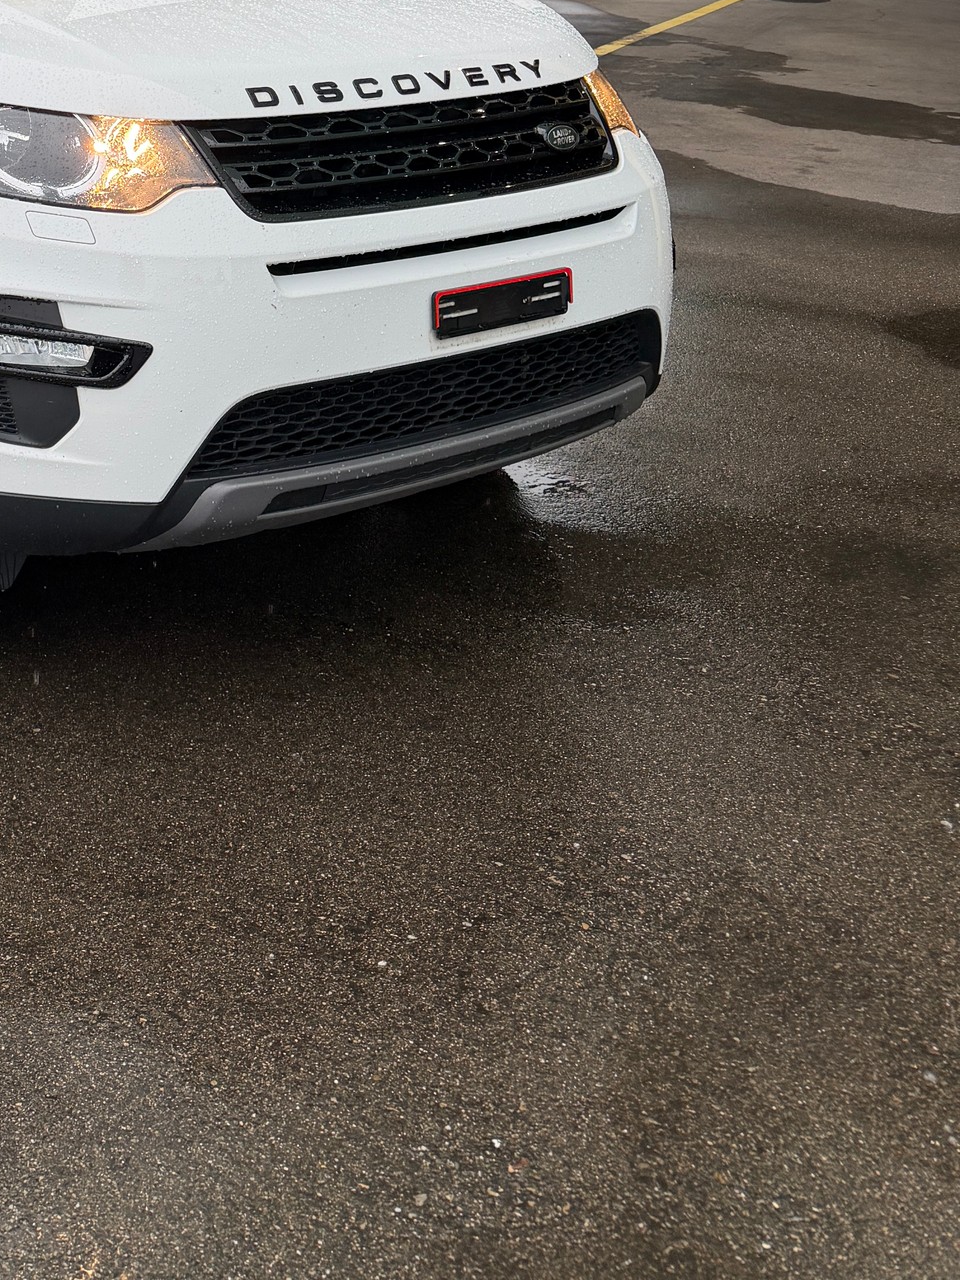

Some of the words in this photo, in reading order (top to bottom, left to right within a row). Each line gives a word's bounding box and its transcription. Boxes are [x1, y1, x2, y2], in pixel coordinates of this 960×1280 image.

[244, 58, 542, 109] DISCOVERY
[552, 128, 569, 138] LAND
[557, 135, 576, 146] ROVER
